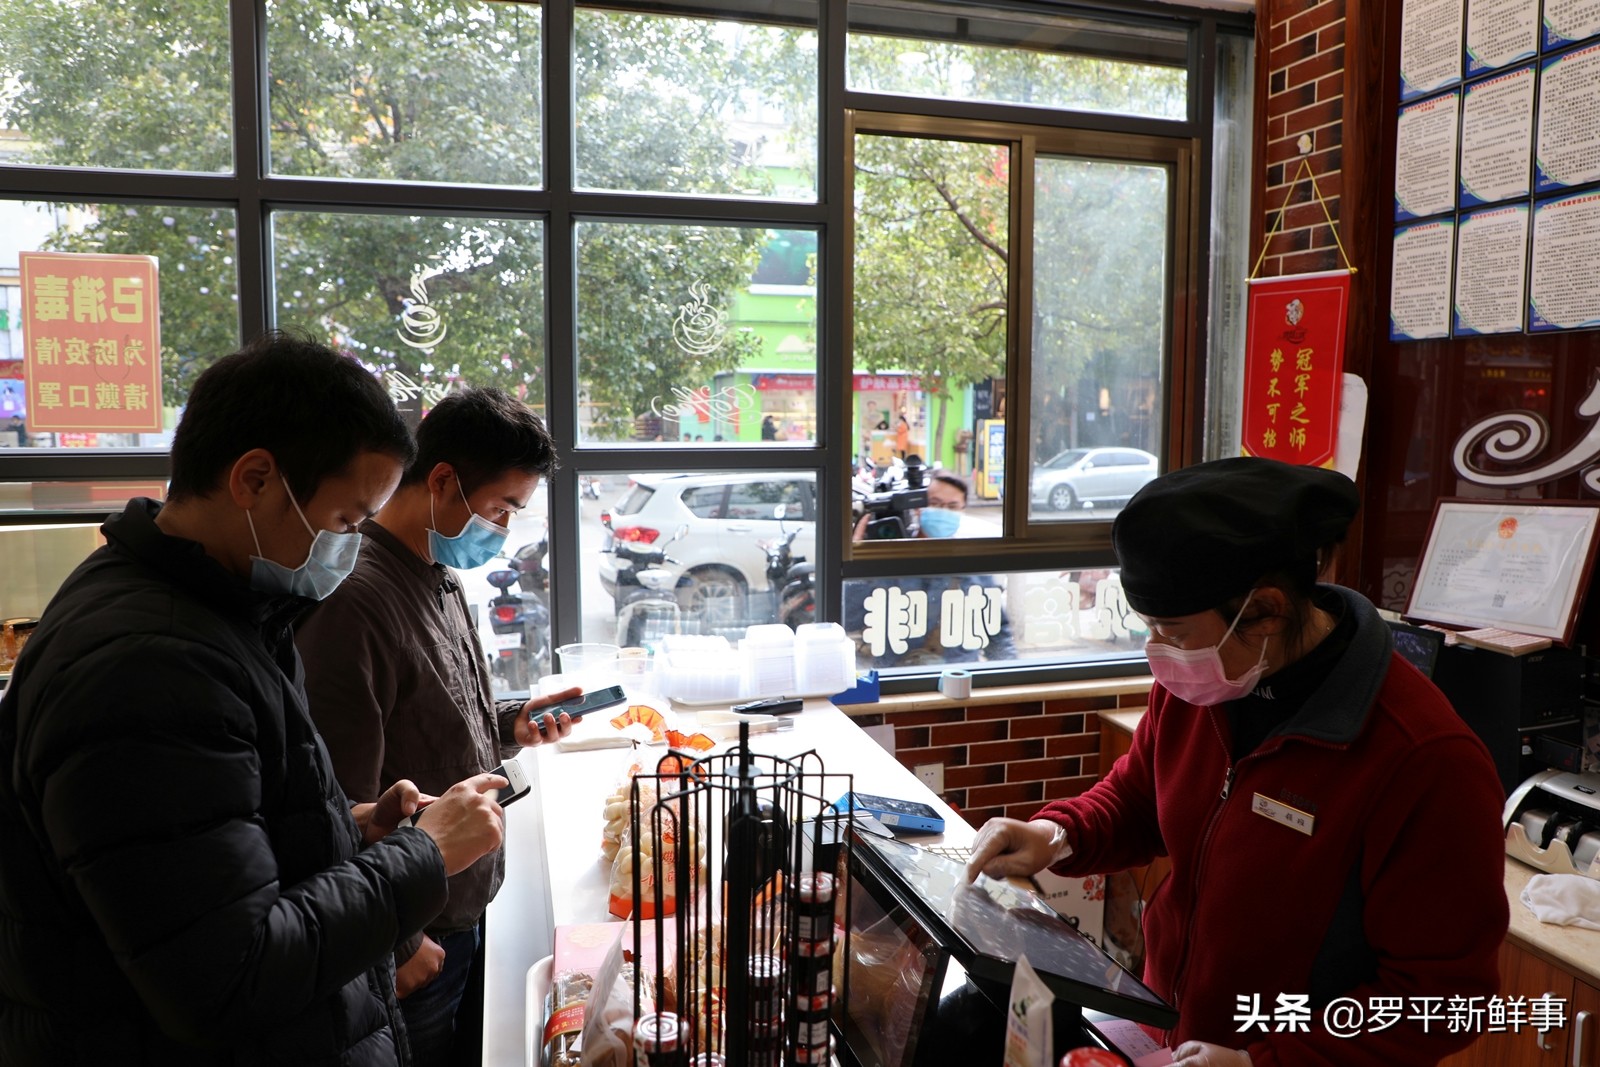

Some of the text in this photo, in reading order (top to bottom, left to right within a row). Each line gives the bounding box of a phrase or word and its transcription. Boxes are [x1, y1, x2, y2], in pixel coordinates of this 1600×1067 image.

[1263, 348, 1285, 449] 势不可挡
[1289, 348, 1313, 452] 冠军之师
